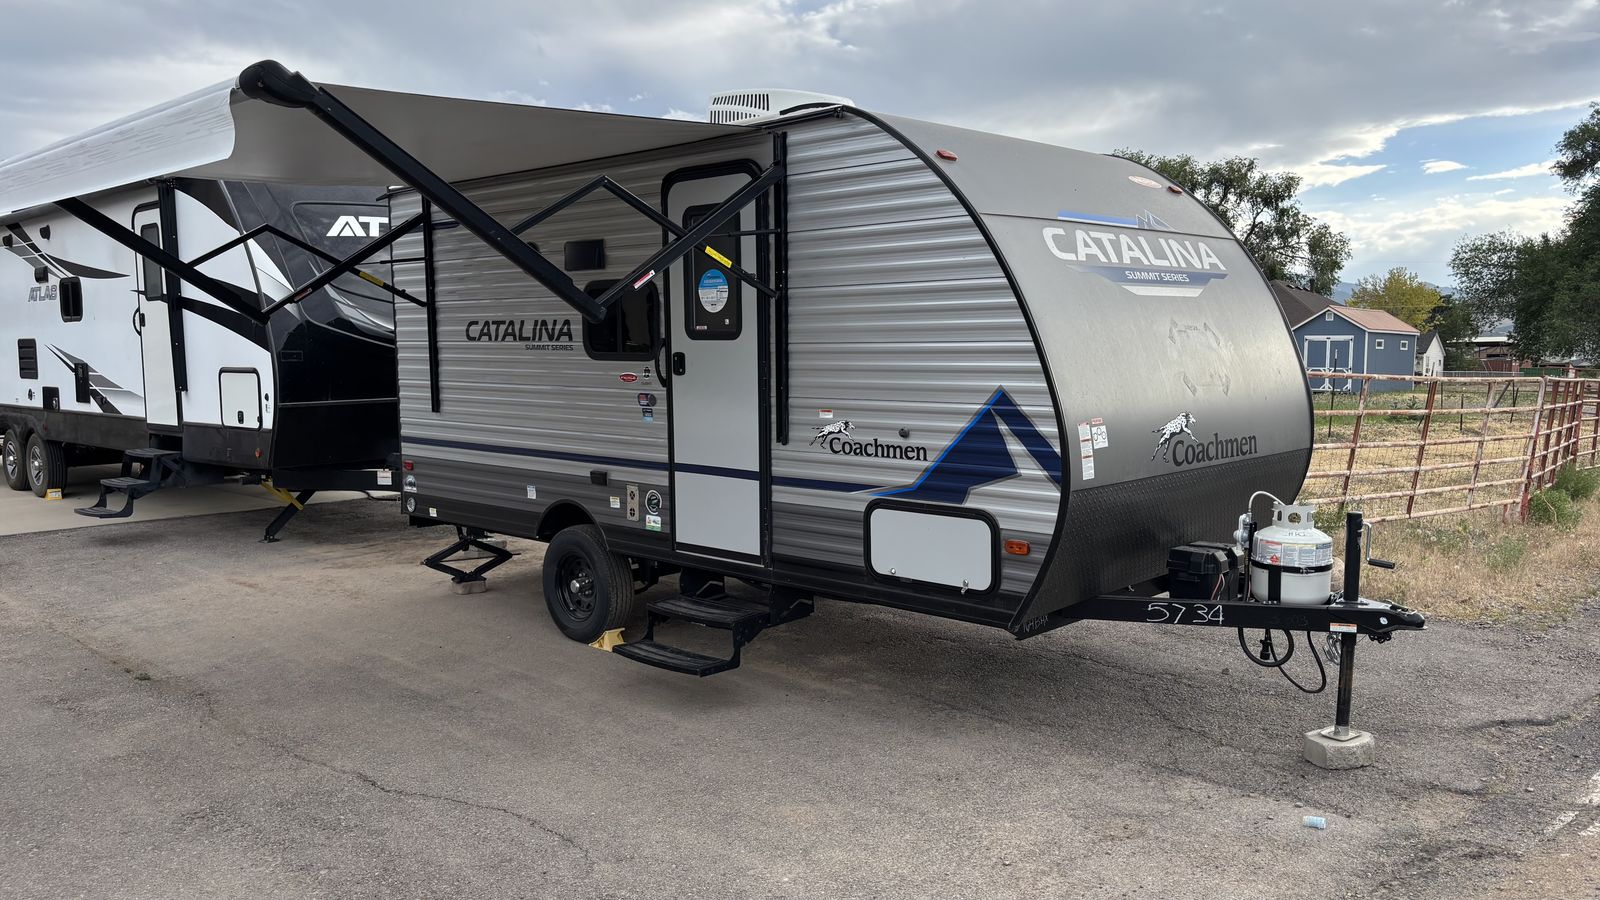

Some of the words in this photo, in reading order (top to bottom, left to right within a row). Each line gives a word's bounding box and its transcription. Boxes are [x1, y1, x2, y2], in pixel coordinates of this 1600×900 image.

[1042, 227, 1227, 271] CATALINA
[1125, 271, 1160, 281] SUMMIT
[1161, 272, 1190, 282] SERIES
[465, 319, 573, 342] CATALINA
[829, 437, 928, 461] Coachmen
[1172, 433, 1258, 467] Coachmen
[1146, 602, 1225, 625] 5734
